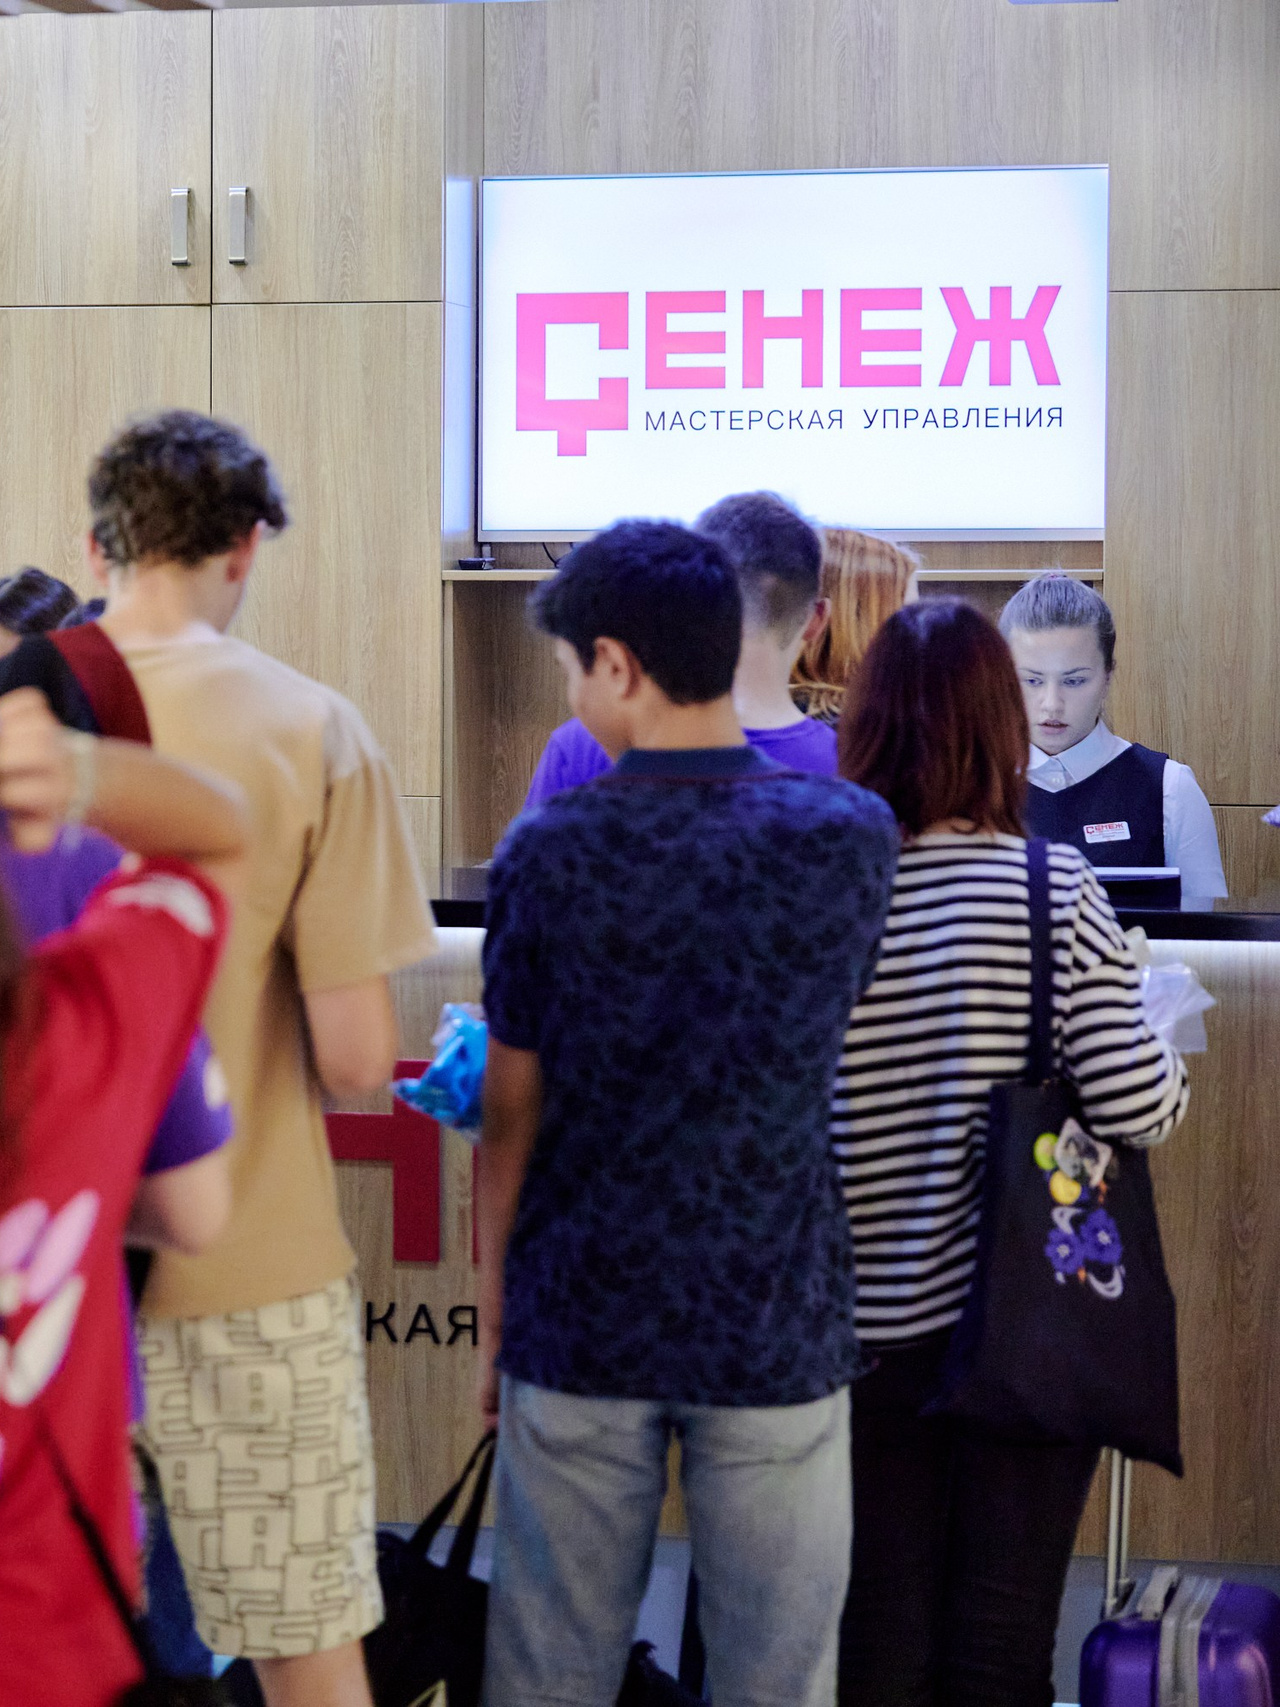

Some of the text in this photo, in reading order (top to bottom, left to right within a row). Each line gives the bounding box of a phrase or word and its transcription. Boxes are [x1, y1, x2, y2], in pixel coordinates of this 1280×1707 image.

[515, 285, 1062, 457] СЕНЕЖ
[644, 407, 1064, 431] МАСТЕРСКАЯ УПРАВЛЕНИЯ
